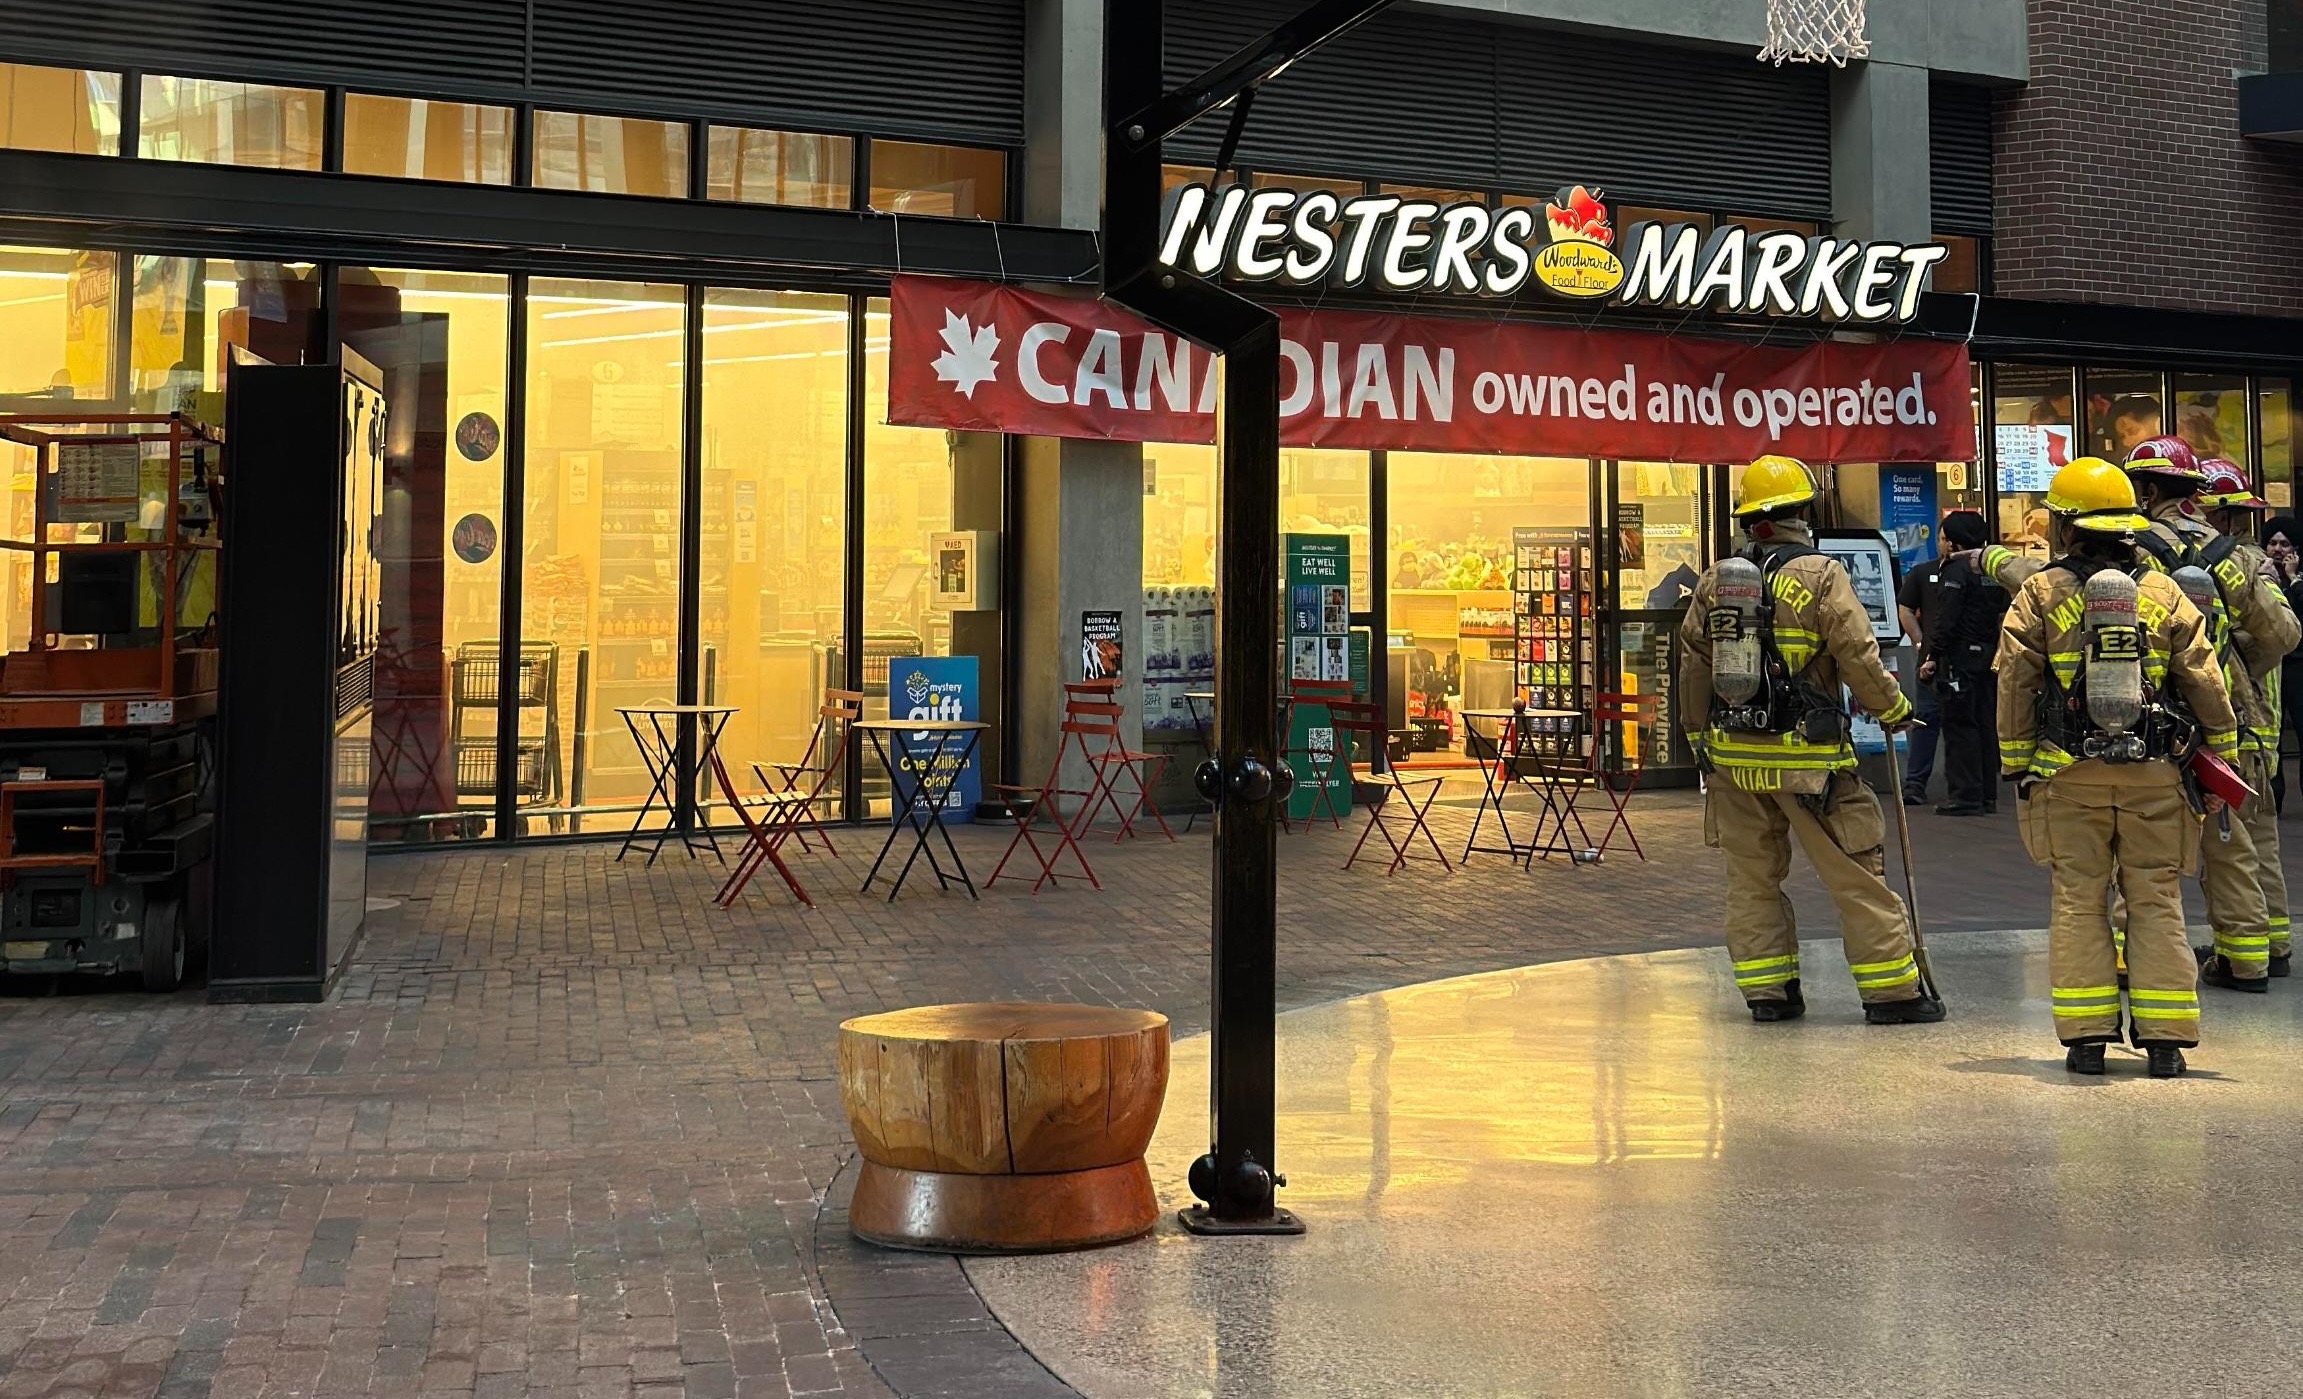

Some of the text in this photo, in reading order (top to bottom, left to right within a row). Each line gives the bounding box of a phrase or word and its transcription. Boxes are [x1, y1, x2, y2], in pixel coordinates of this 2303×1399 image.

[1159, 187, 1947, 320] NESTERS MARKET
[1544, 245, 1617, 273] Woodward's
[1552, 274, 1608, 289] Food Floor
[1017, 322, 1937, 441] CANDIAN owned and operated.
[1953, 469, 1960, 480] 6
[1893, 484, 1921, 495] So many
[1893, 495, 1921, 503] rewards.
[1302, 558, 1336, 567] EAT WELL
[1302, 568, 1336, 576] LIVE WELL
[1112, 616, 1118, 624] A
[1710, 615, 1737, 632] E2
[1084, 625, 1121, 633] BASKETBALL
[2101, 633, 2138, 651] E2
[929, 682, 962, 694] mystery
[1656, 632, 1670, 763] The Province
[908, 693, 963, 741] gift
